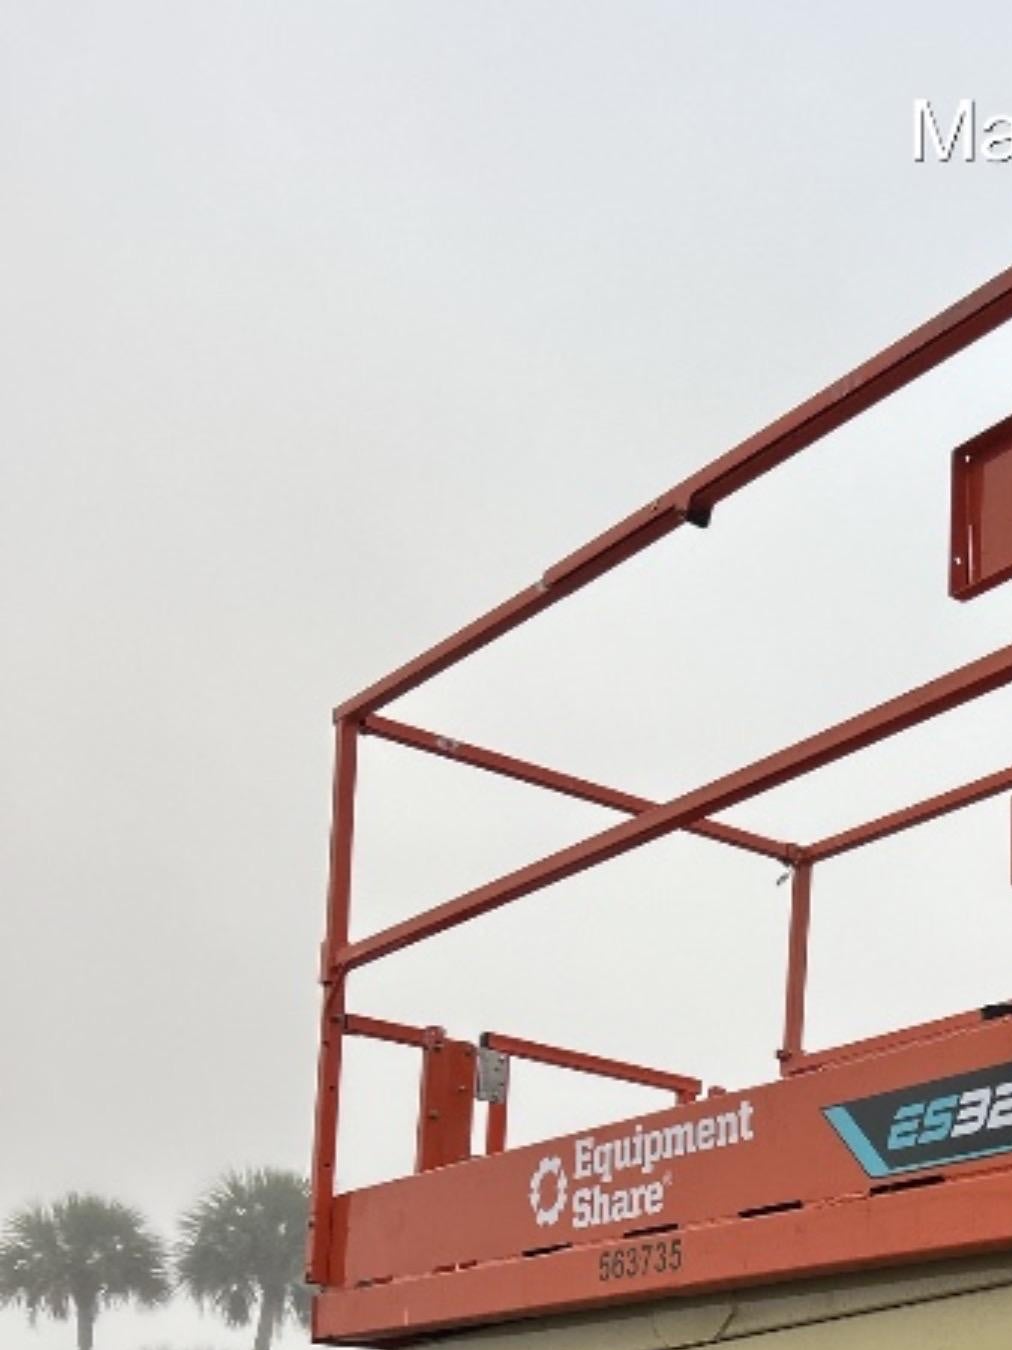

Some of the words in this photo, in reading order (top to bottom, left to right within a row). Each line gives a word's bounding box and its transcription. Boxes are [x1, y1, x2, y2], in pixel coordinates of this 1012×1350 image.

[574, 1099, 754, 1182] Equipment
[572, 1179, 664, 1229] Share
[599, 1239, 682, 1282] 563735
